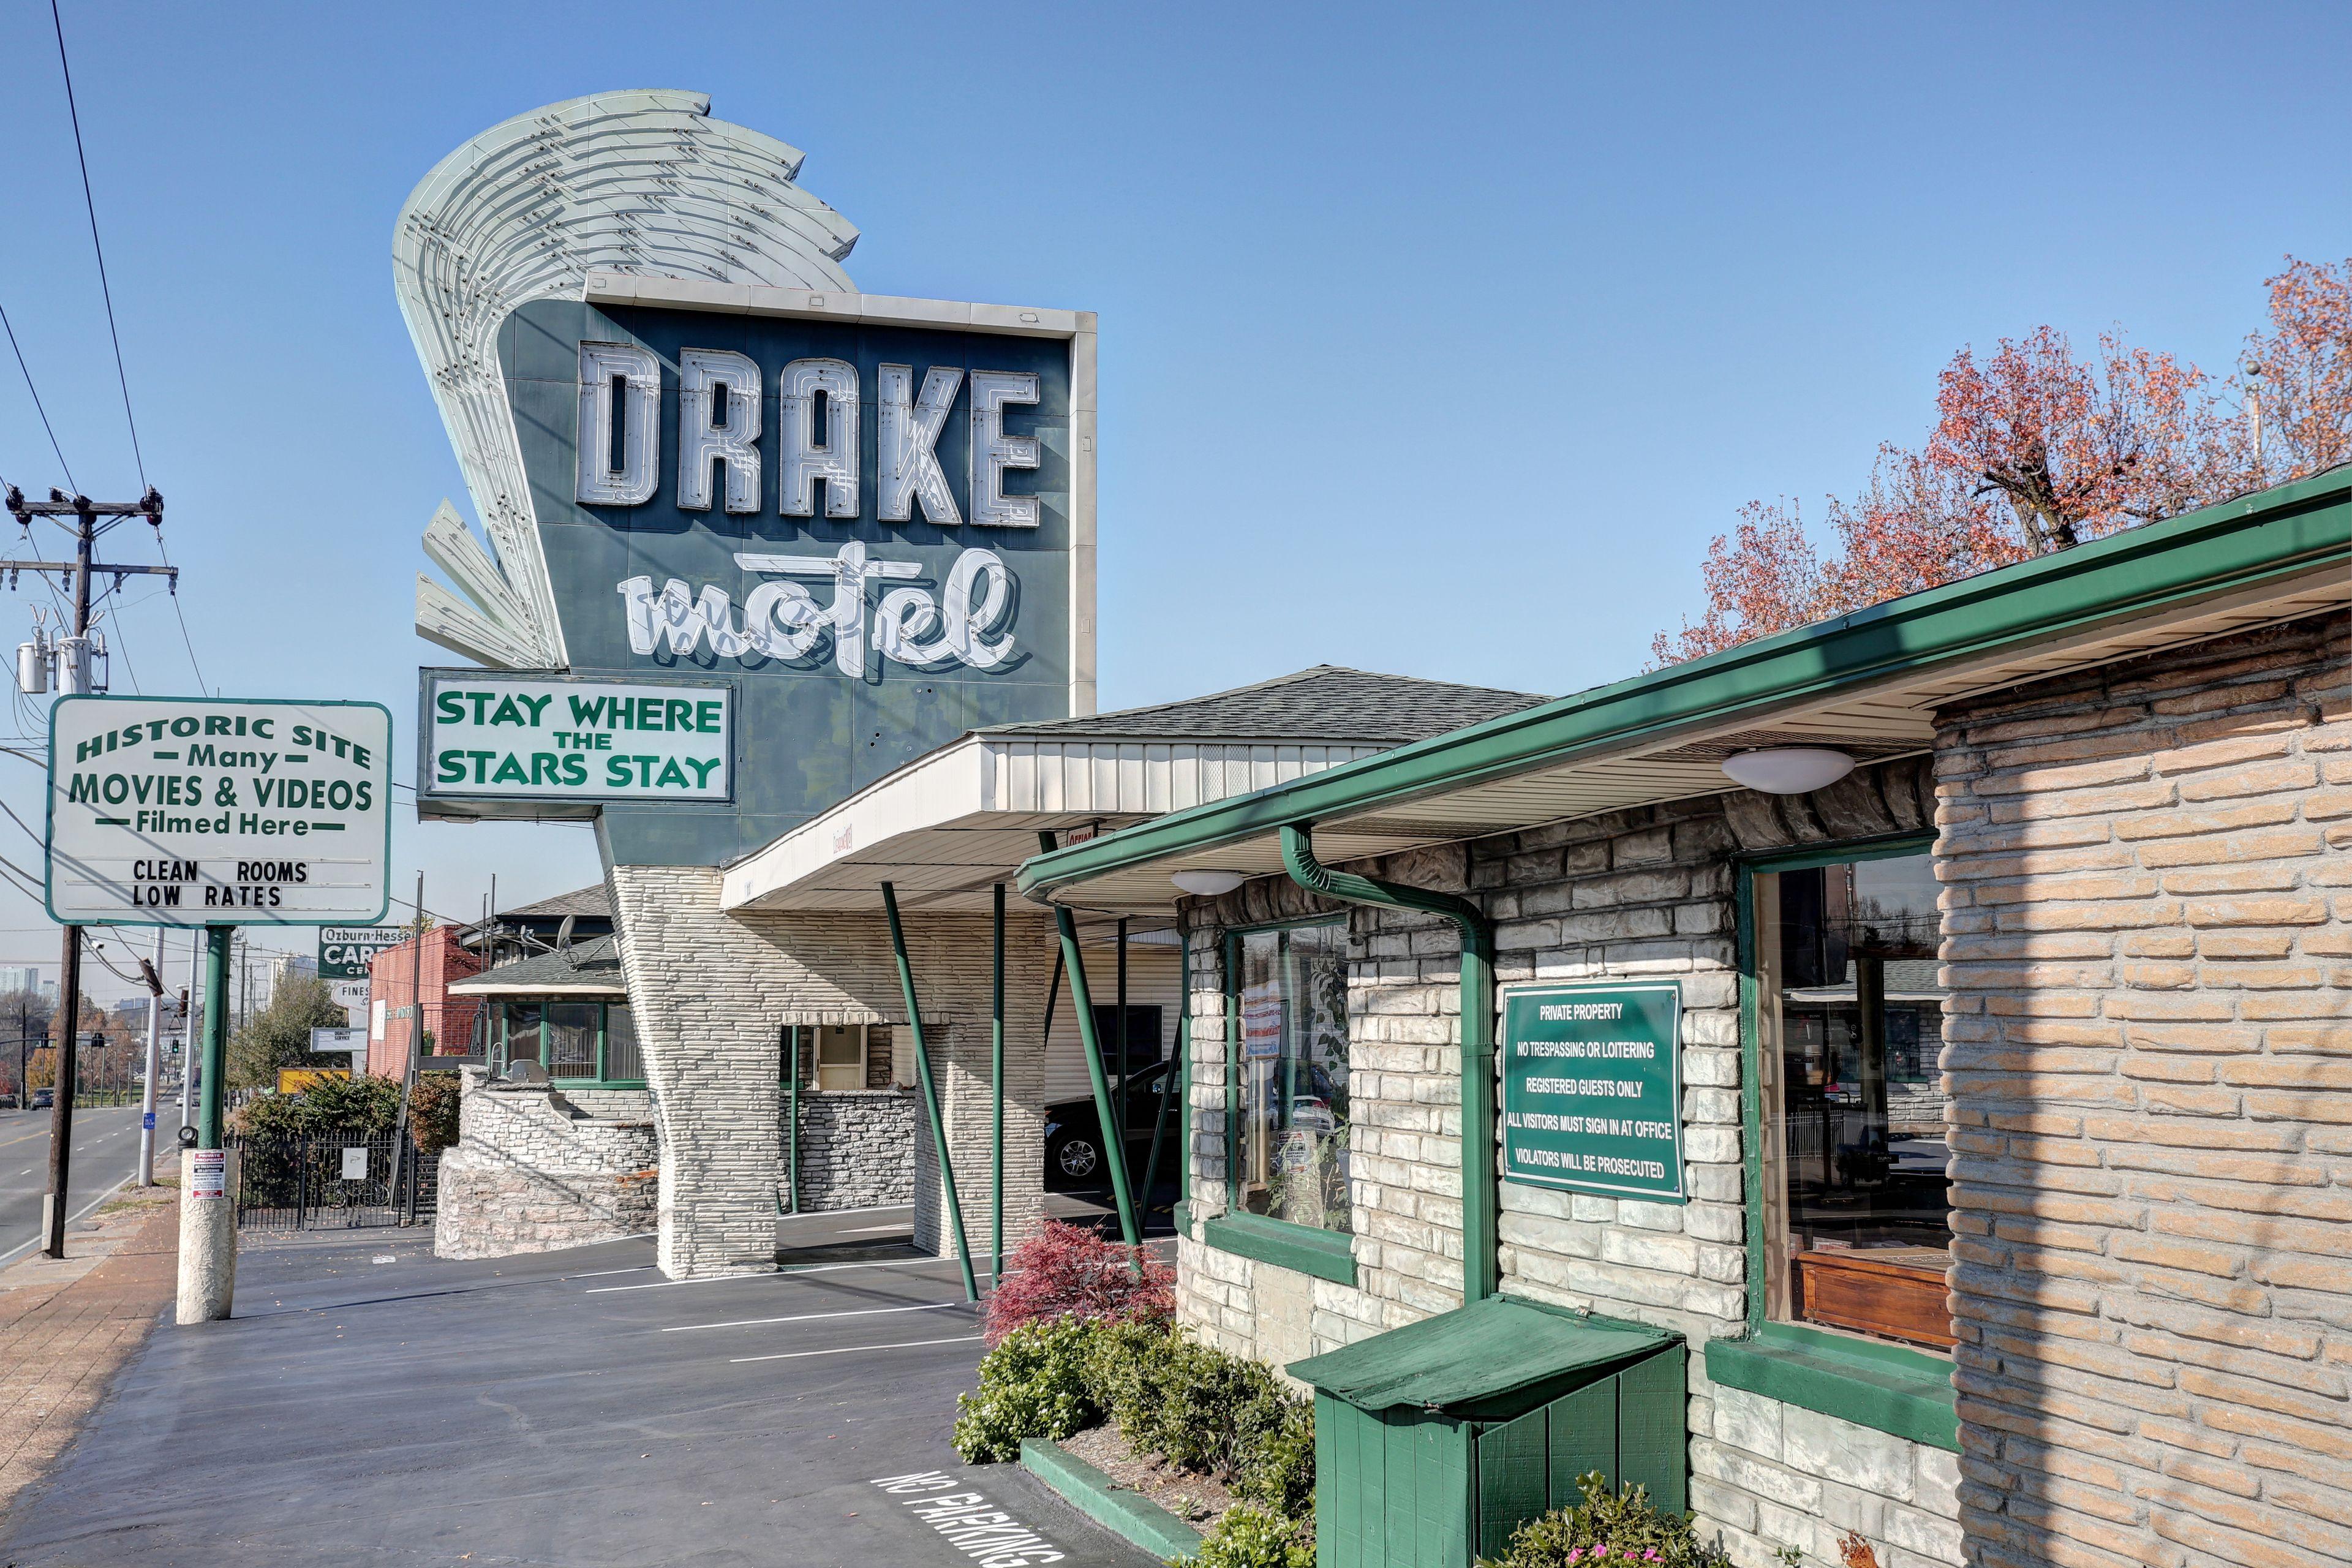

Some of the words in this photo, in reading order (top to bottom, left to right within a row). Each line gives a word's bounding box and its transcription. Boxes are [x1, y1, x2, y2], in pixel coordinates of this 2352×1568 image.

[575, 340, 1041, 527] DRAKE
[617, 541, 1016, 678] motel
[437, 691, 552, 728] STAY
[567, 695, 723, 733] WHERE
[76, 715, 274, 764] HISTORIC
[292, 725, 371, 770] SITE
[552, 731, 612, 750] THE
[187, 744, 279, 774] Many
[437, 750, 588, 786] STARS
[606, 755, 721, 790] STAY
[68, 773, 202, 807] MOVIES
[214, 777, 238, 807] &
[252, 778, 372, 811] VIDEOS
[137, 811, 230, 834] Filmed
[239, 813, 309, 835] Here
[133, 860, 198, 881] CLEAN
[237, 862, 307, 883] ROOMS
[133, 886, 181, 906] LOW
[205, 886, 281, 907] RATES
[1540, 1005, 1572, 1020] PRIVATE
[1574, 1003, 1623, 1020] PROPERTY
[1517, 1042, 1528, 1057] NO
[1530, 1041, 1585, 1058] TRESPASSING
[1587, 1042, 1600, 1058] OR
[1602, 1042, 1654, 1059] LOITERING
[1526, 1077, 1577, 1095] REGISTERED
[1579, 1079, 1615, 1097] GUESTS
[1617, 1081, 1643, 1098] ONLY
[1507, 1112, 1522, 1128] ALL
[1523, 1113, 1559, 1131] VISITORS
[1560, 1115, 1584, 1133] MUST
[1586, 1117, 1607, 1134] SIGN
[1609, 1118, 1619, 1136] IN
[1621, 1120, 1633, 1137] AT
[1635, 1121, 1673, 1140] OFFICE
[1515, 1147, 1559, 1168] VIOLATORS
[1561, 1152, 1582, 1170] WILL
[1583, 1155, 1596, 1172] BE
[1597, 1156, 1665, 1179] PROSECUTED
[870, 1471, 959, 1493] NO
[902, 1492, 1065, 1568] PARKING
